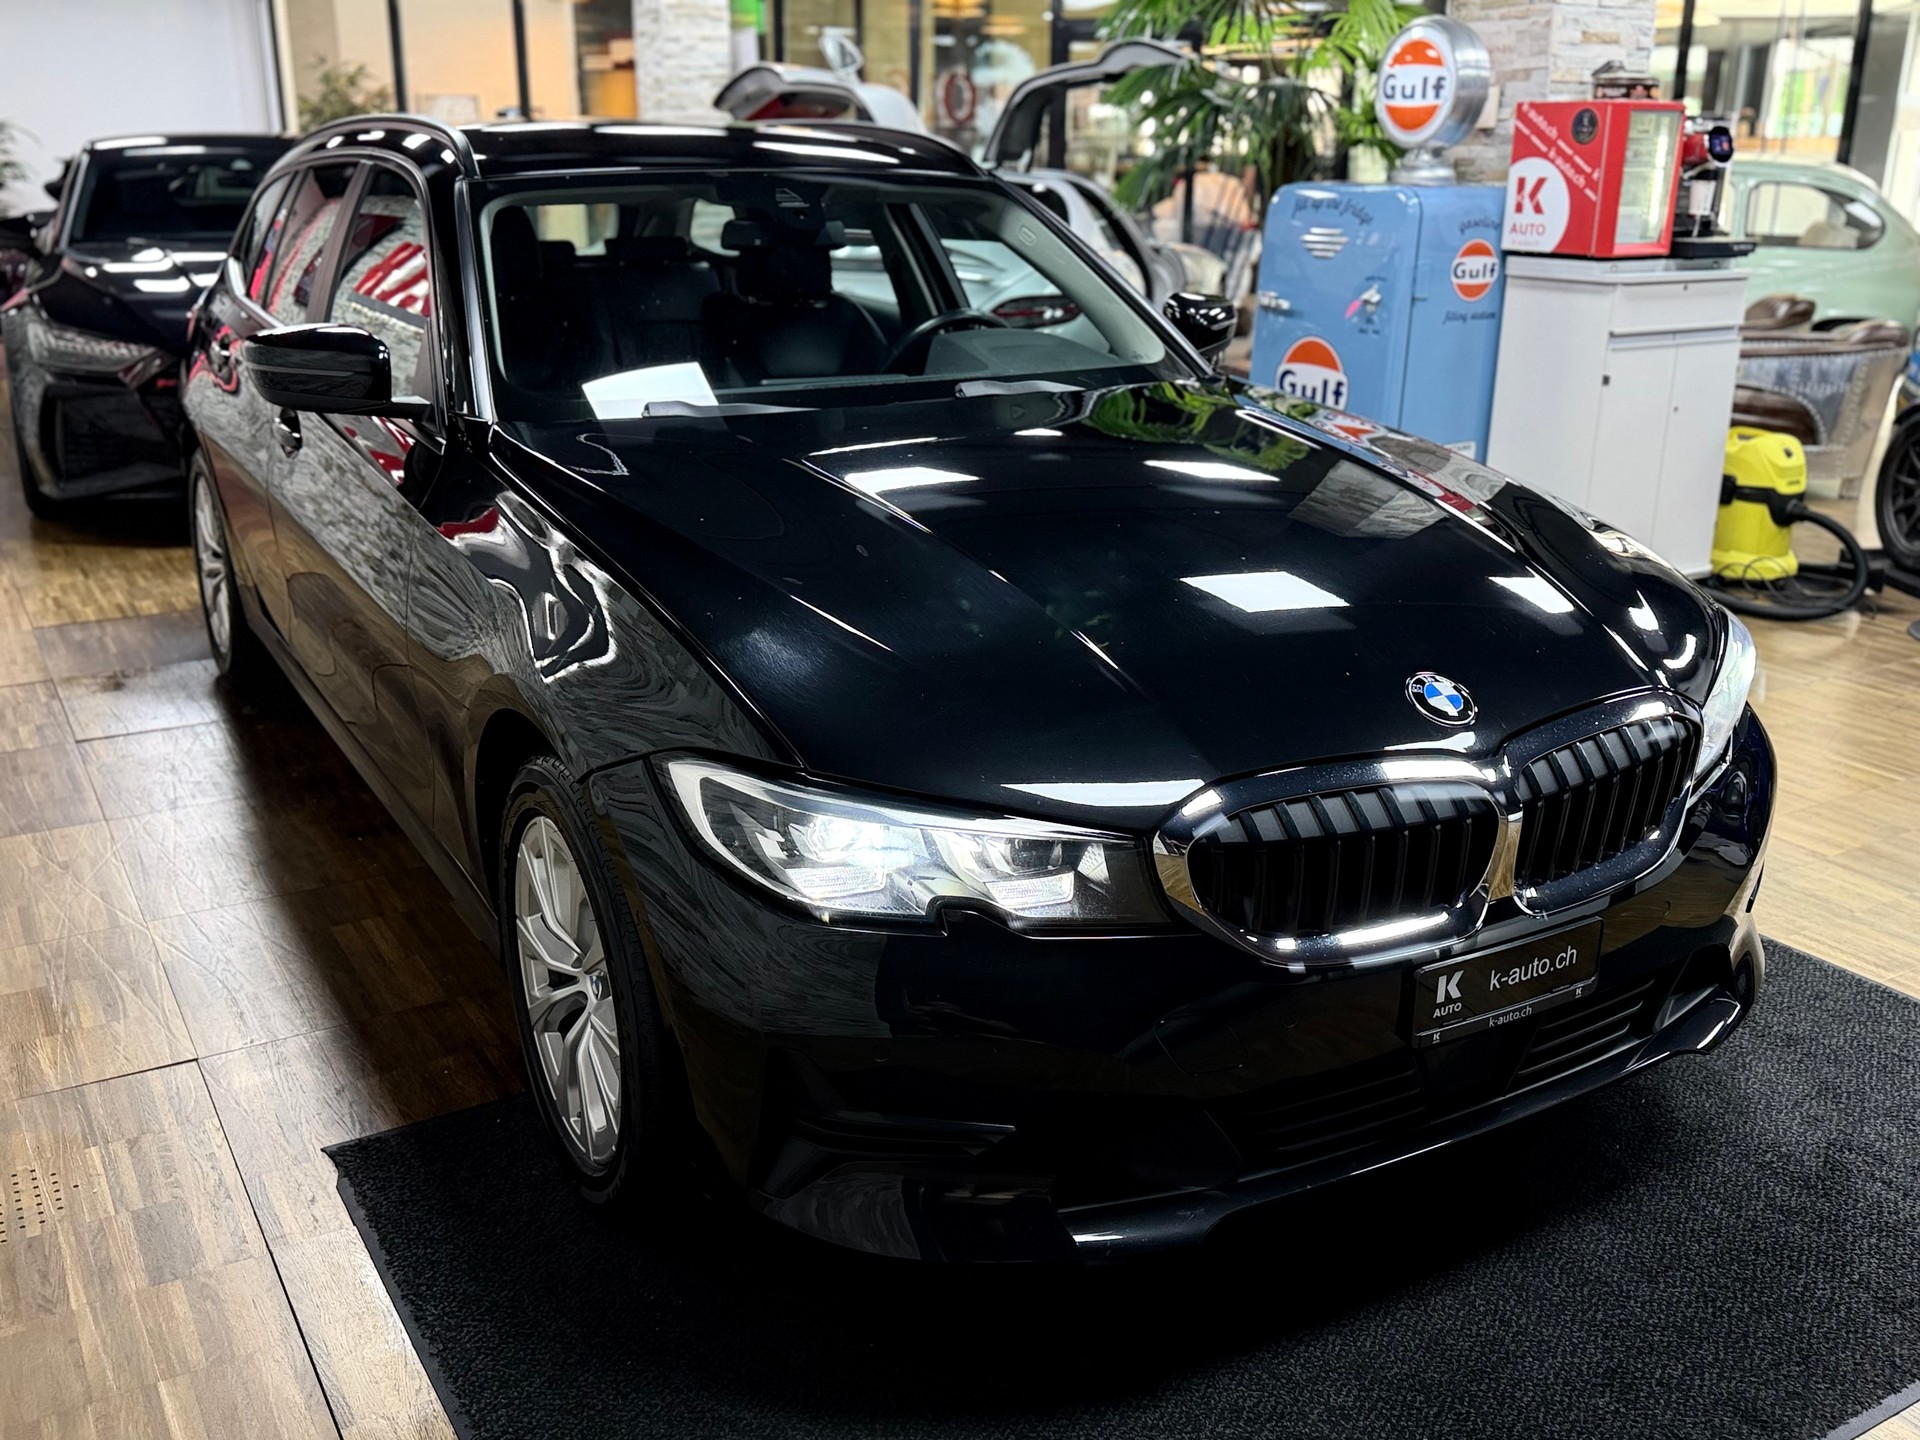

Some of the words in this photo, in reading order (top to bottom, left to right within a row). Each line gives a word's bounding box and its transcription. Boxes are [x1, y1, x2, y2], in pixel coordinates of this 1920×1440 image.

[1383, 74, 1447, 100] Gulf
[1515, 176, 1548, 215] K
[1510, 222, 1546, 237] AUTO
[1453, 261, 1498, 280] Gulf
[1279, 369, 1344, 405] Gulf
[1489, 945, 1577, 991] k-auto.ch
[1436, 969, 1464, 1004] K
[1432, 1002, 1462, 1019] AUTO
[1488, 1005, 1533, 1028] k-auto.ch
